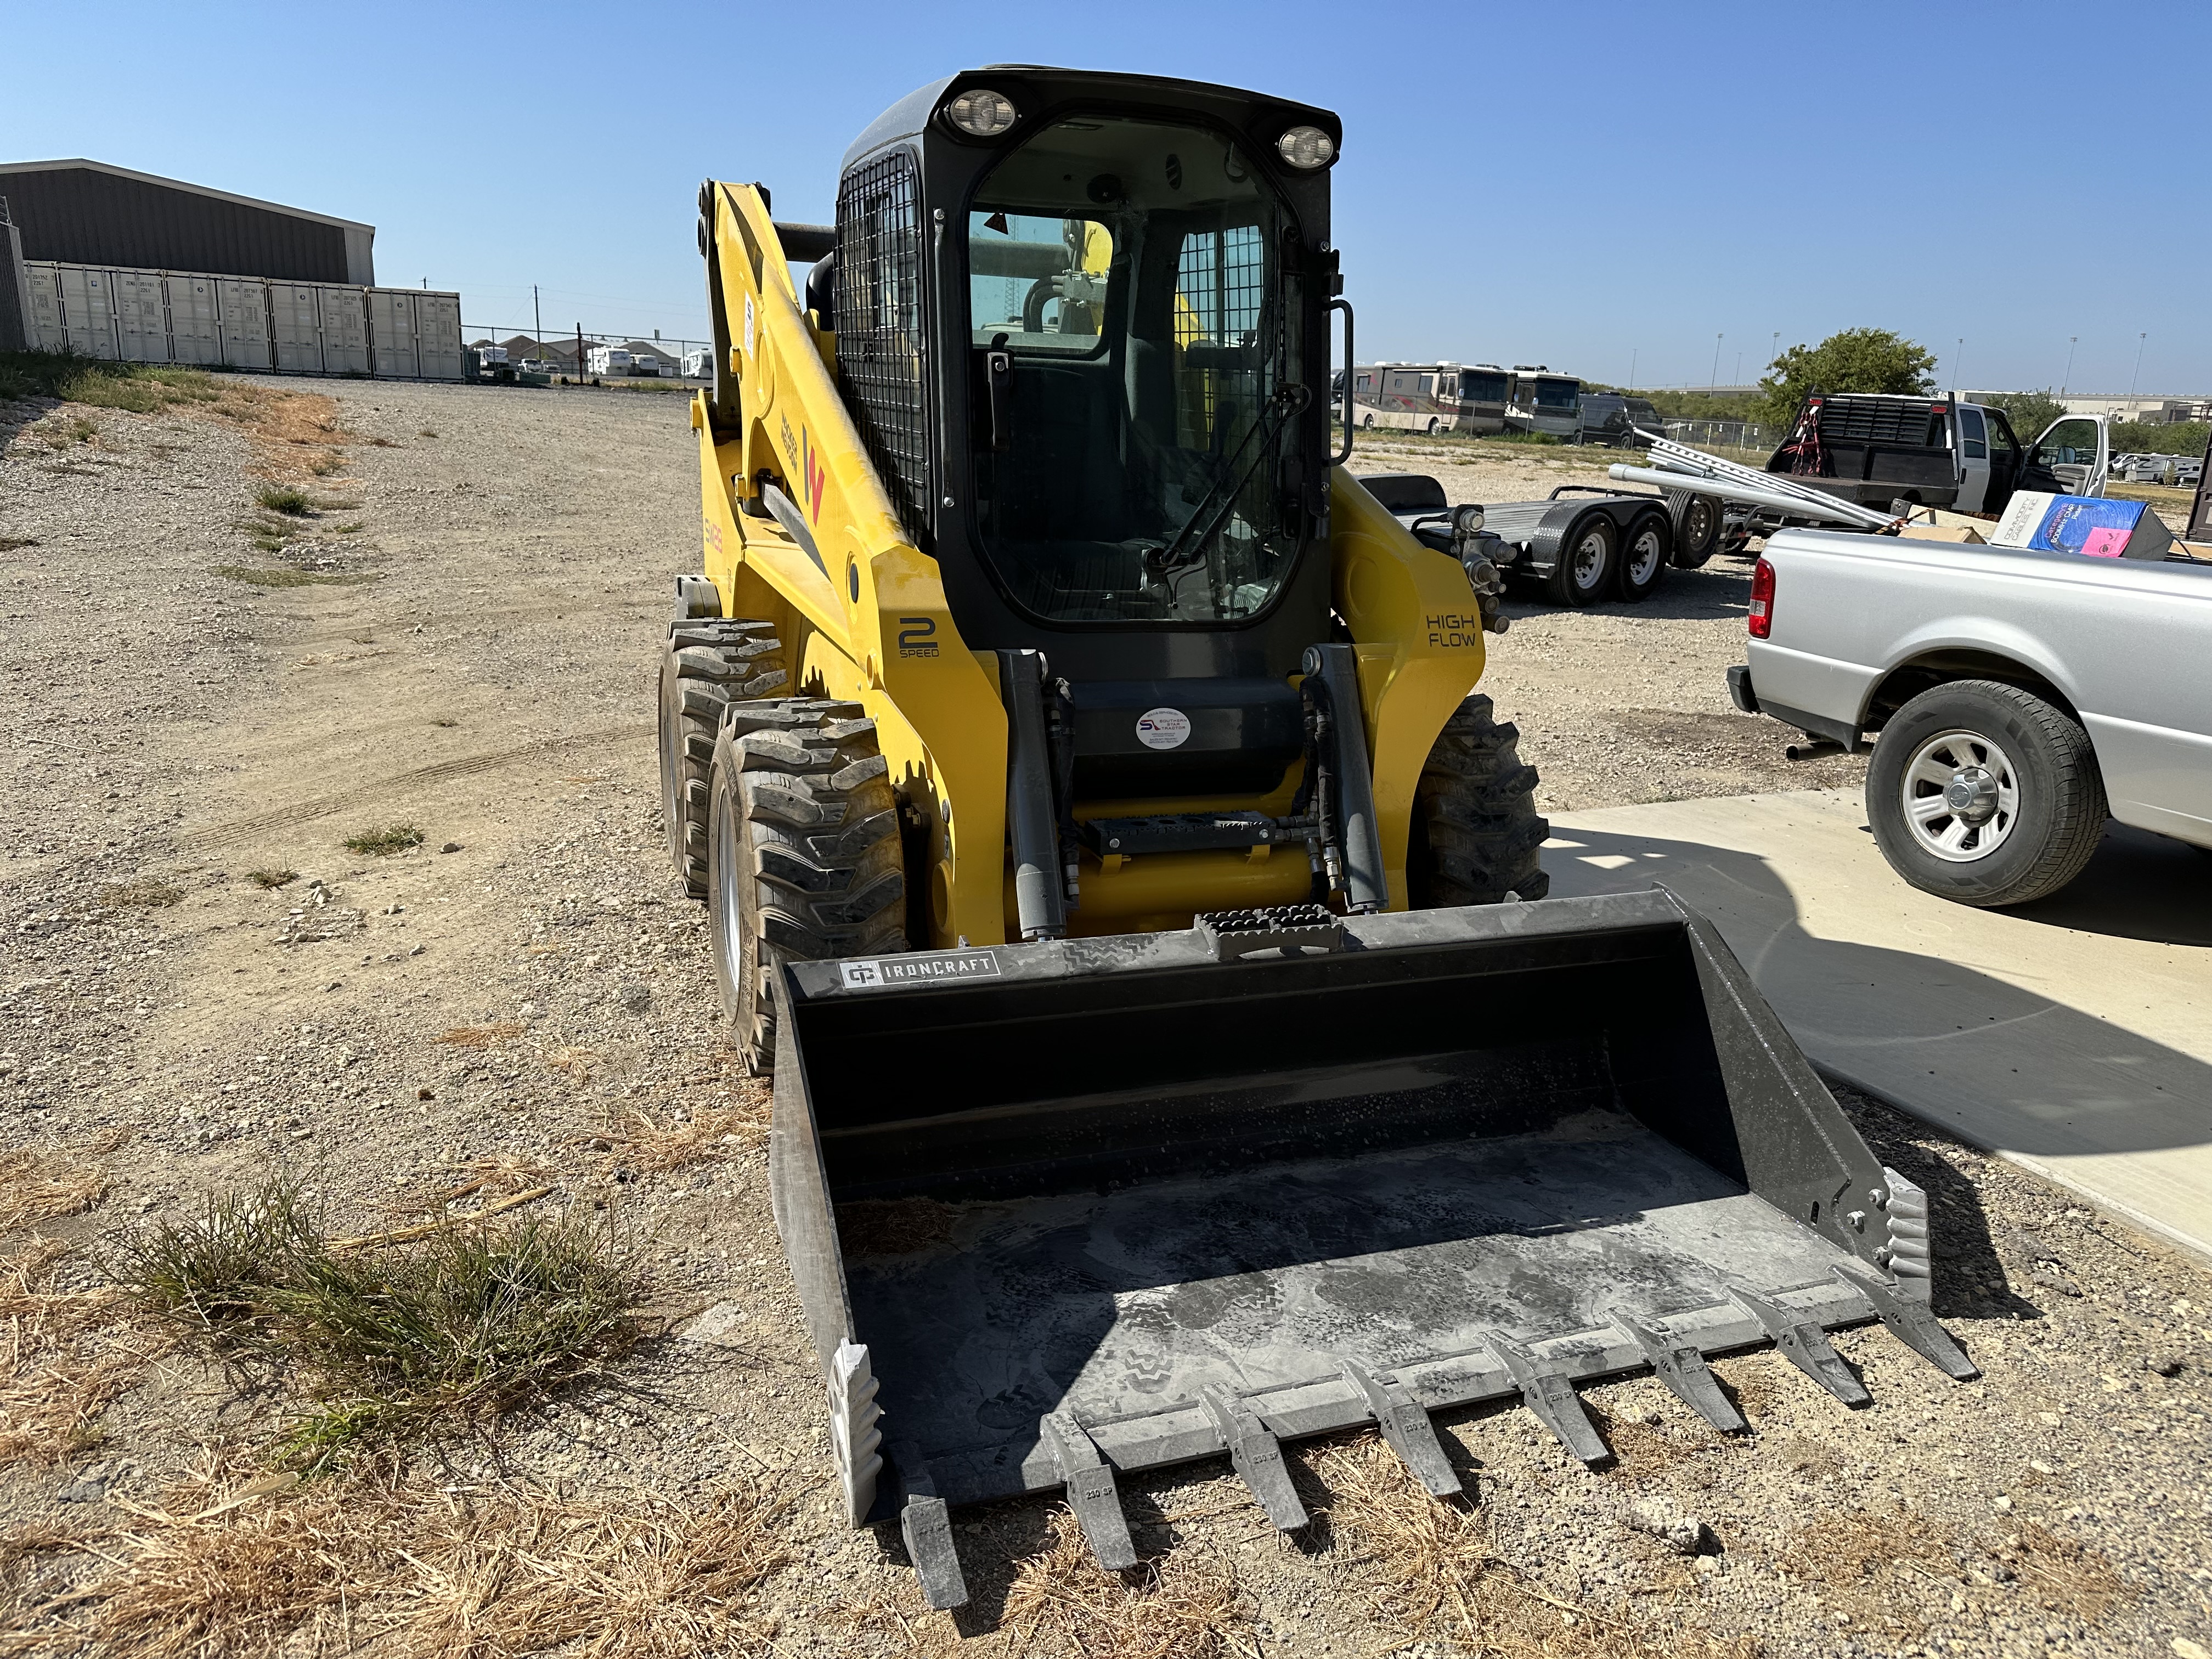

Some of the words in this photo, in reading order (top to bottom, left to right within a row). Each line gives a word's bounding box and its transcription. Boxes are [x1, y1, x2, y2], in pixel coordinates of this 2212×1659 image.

[2004, 496, 2031, 540] COMMODITY
[2072, 504, 2084, 520] Riser
[2051, 518, 2068, 543] 600MHz
[2064, 504, 2075, 517] CMR
[1426, 614, 1475, 629] HIGH
[899, 617, 938, 649] 2
[1429, 633, 1476, 647] FLOW
[900, 649, 939, 658] SPEED
[884, 958, 989, 978] IRONCRAFT
[1252, 1454, 1267, 1464] 230
[1269, 1452, 1278, 1460] SP
[1086, 1489, 1101, 1500] 230
[1103, 1487, 1113, 1496] SP
